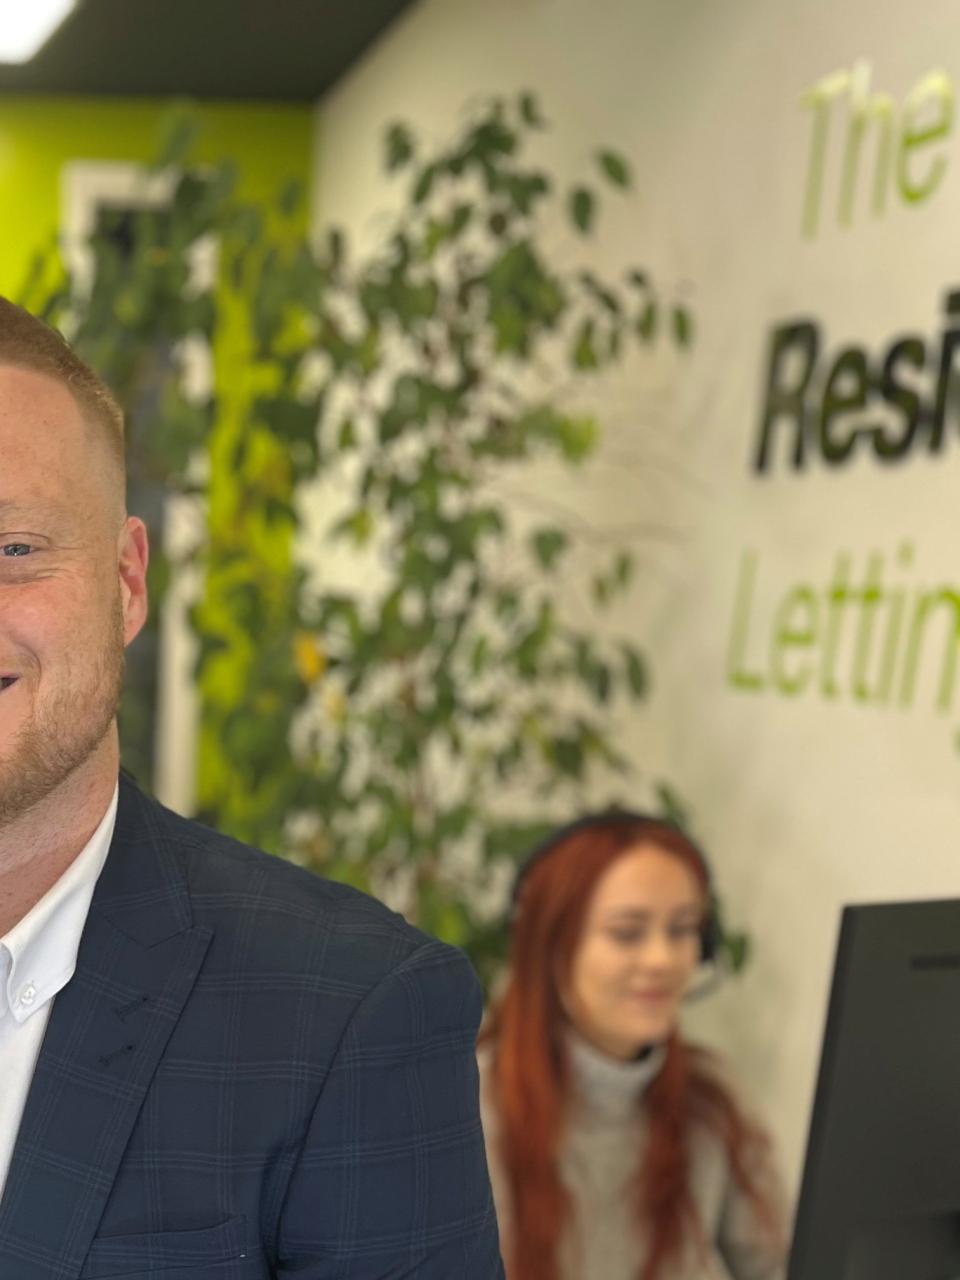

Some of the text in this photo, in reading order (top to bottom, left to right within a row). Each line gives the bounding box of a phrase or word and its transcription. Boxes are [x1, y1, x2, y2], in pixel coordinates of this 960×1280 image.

[798, 58, 954, 240] The
[752, 288, 960, 475] Resi
[725, 540, 960, 740] Lettin
